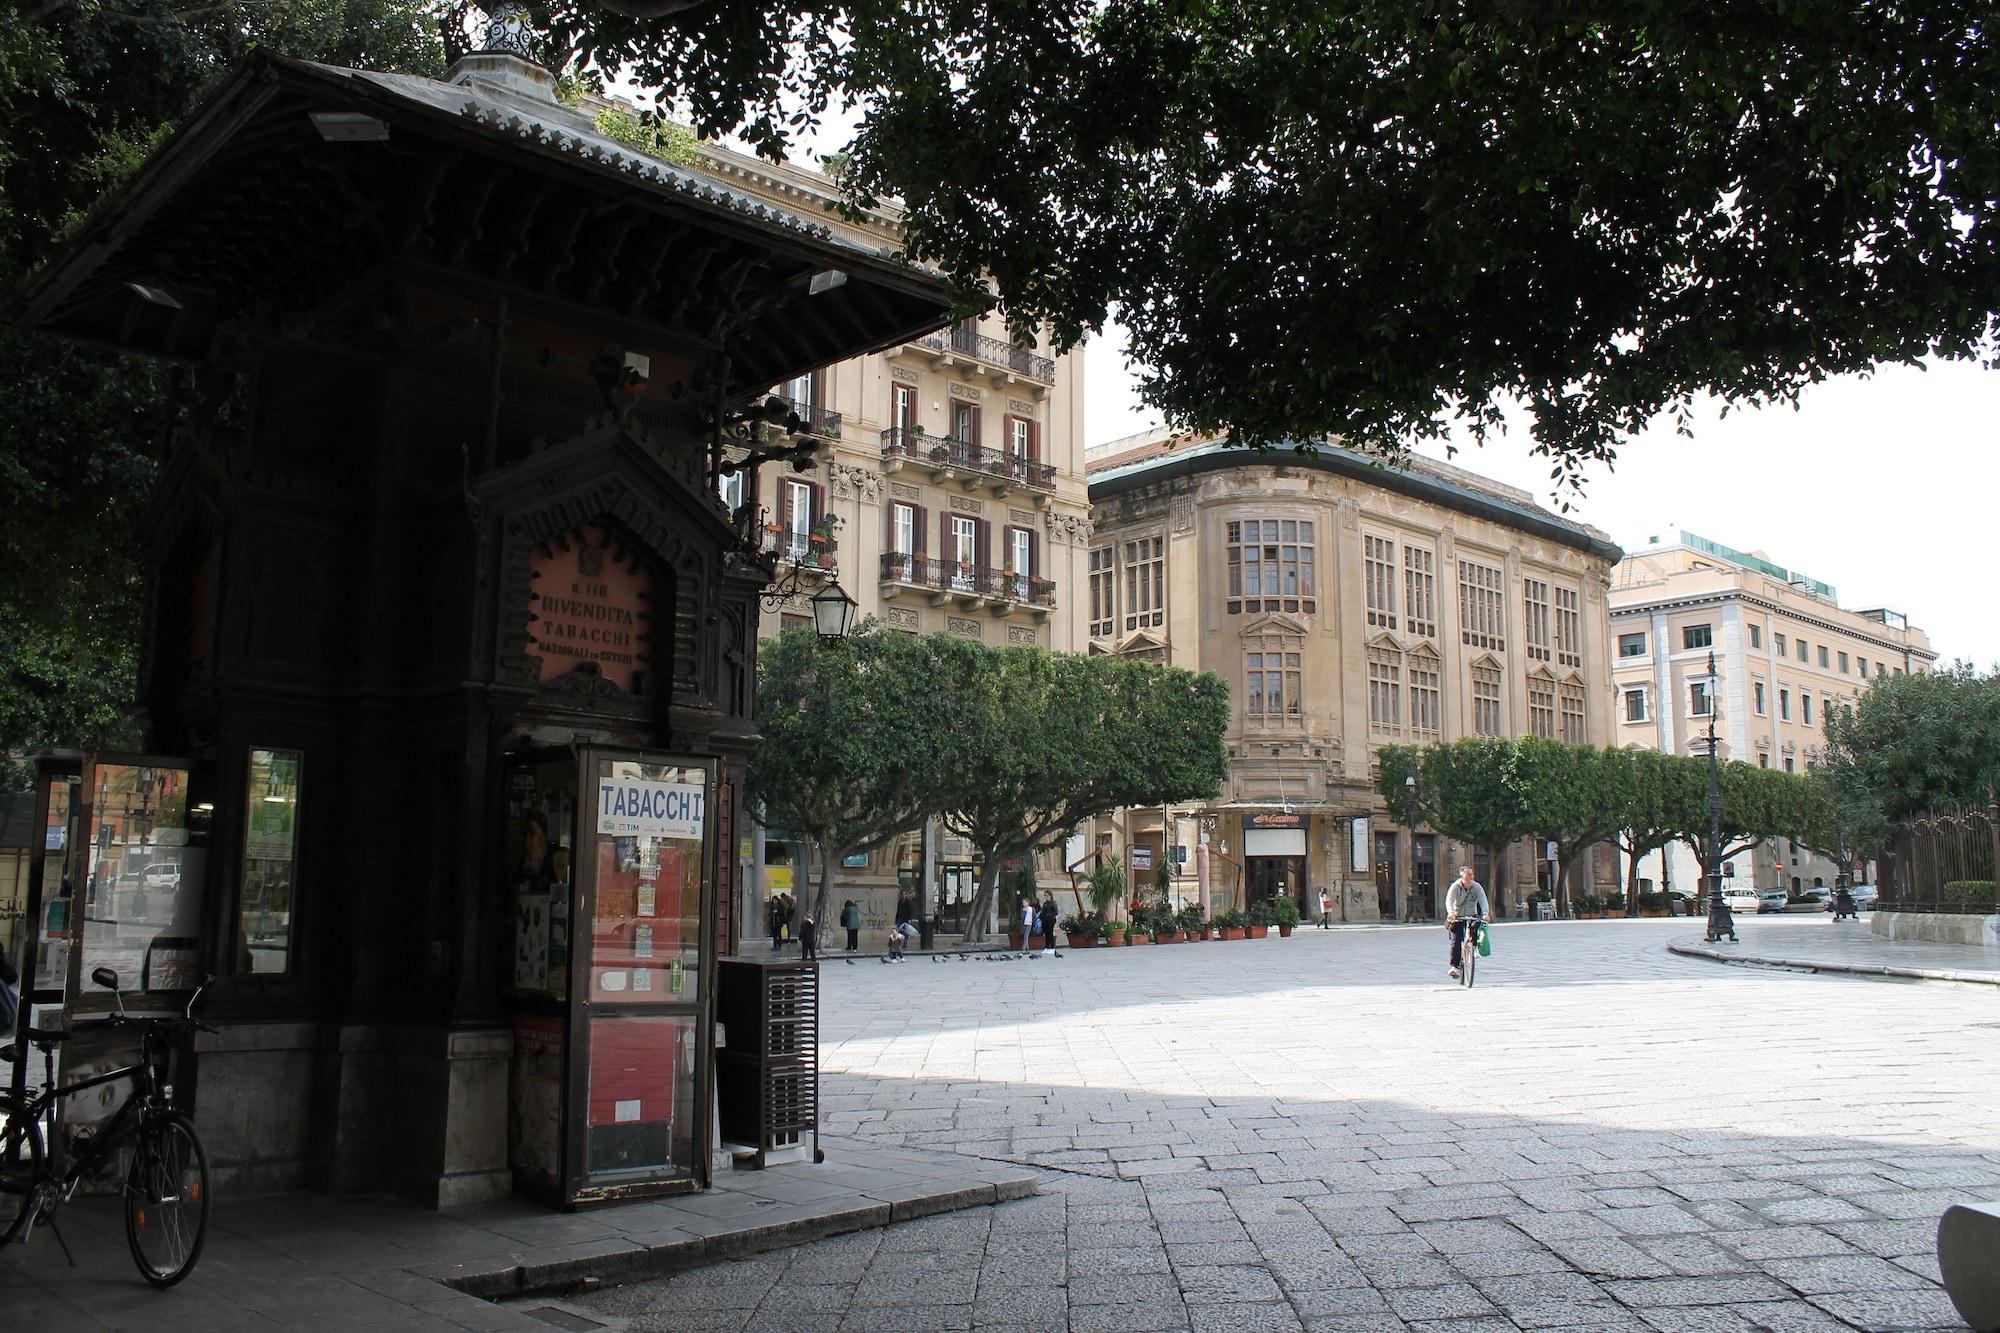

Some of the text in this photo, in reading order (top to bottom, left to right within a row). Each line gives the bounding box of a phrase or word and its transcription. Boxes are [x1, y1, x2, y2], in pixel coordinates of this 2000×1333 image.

[542, 596, 632, 624] RIVENDITA
[544, 621, 630, 646] TABACCHI
[601, 785, 702, 821] TABACCHI
[626, 824, 640, 832] TIM
